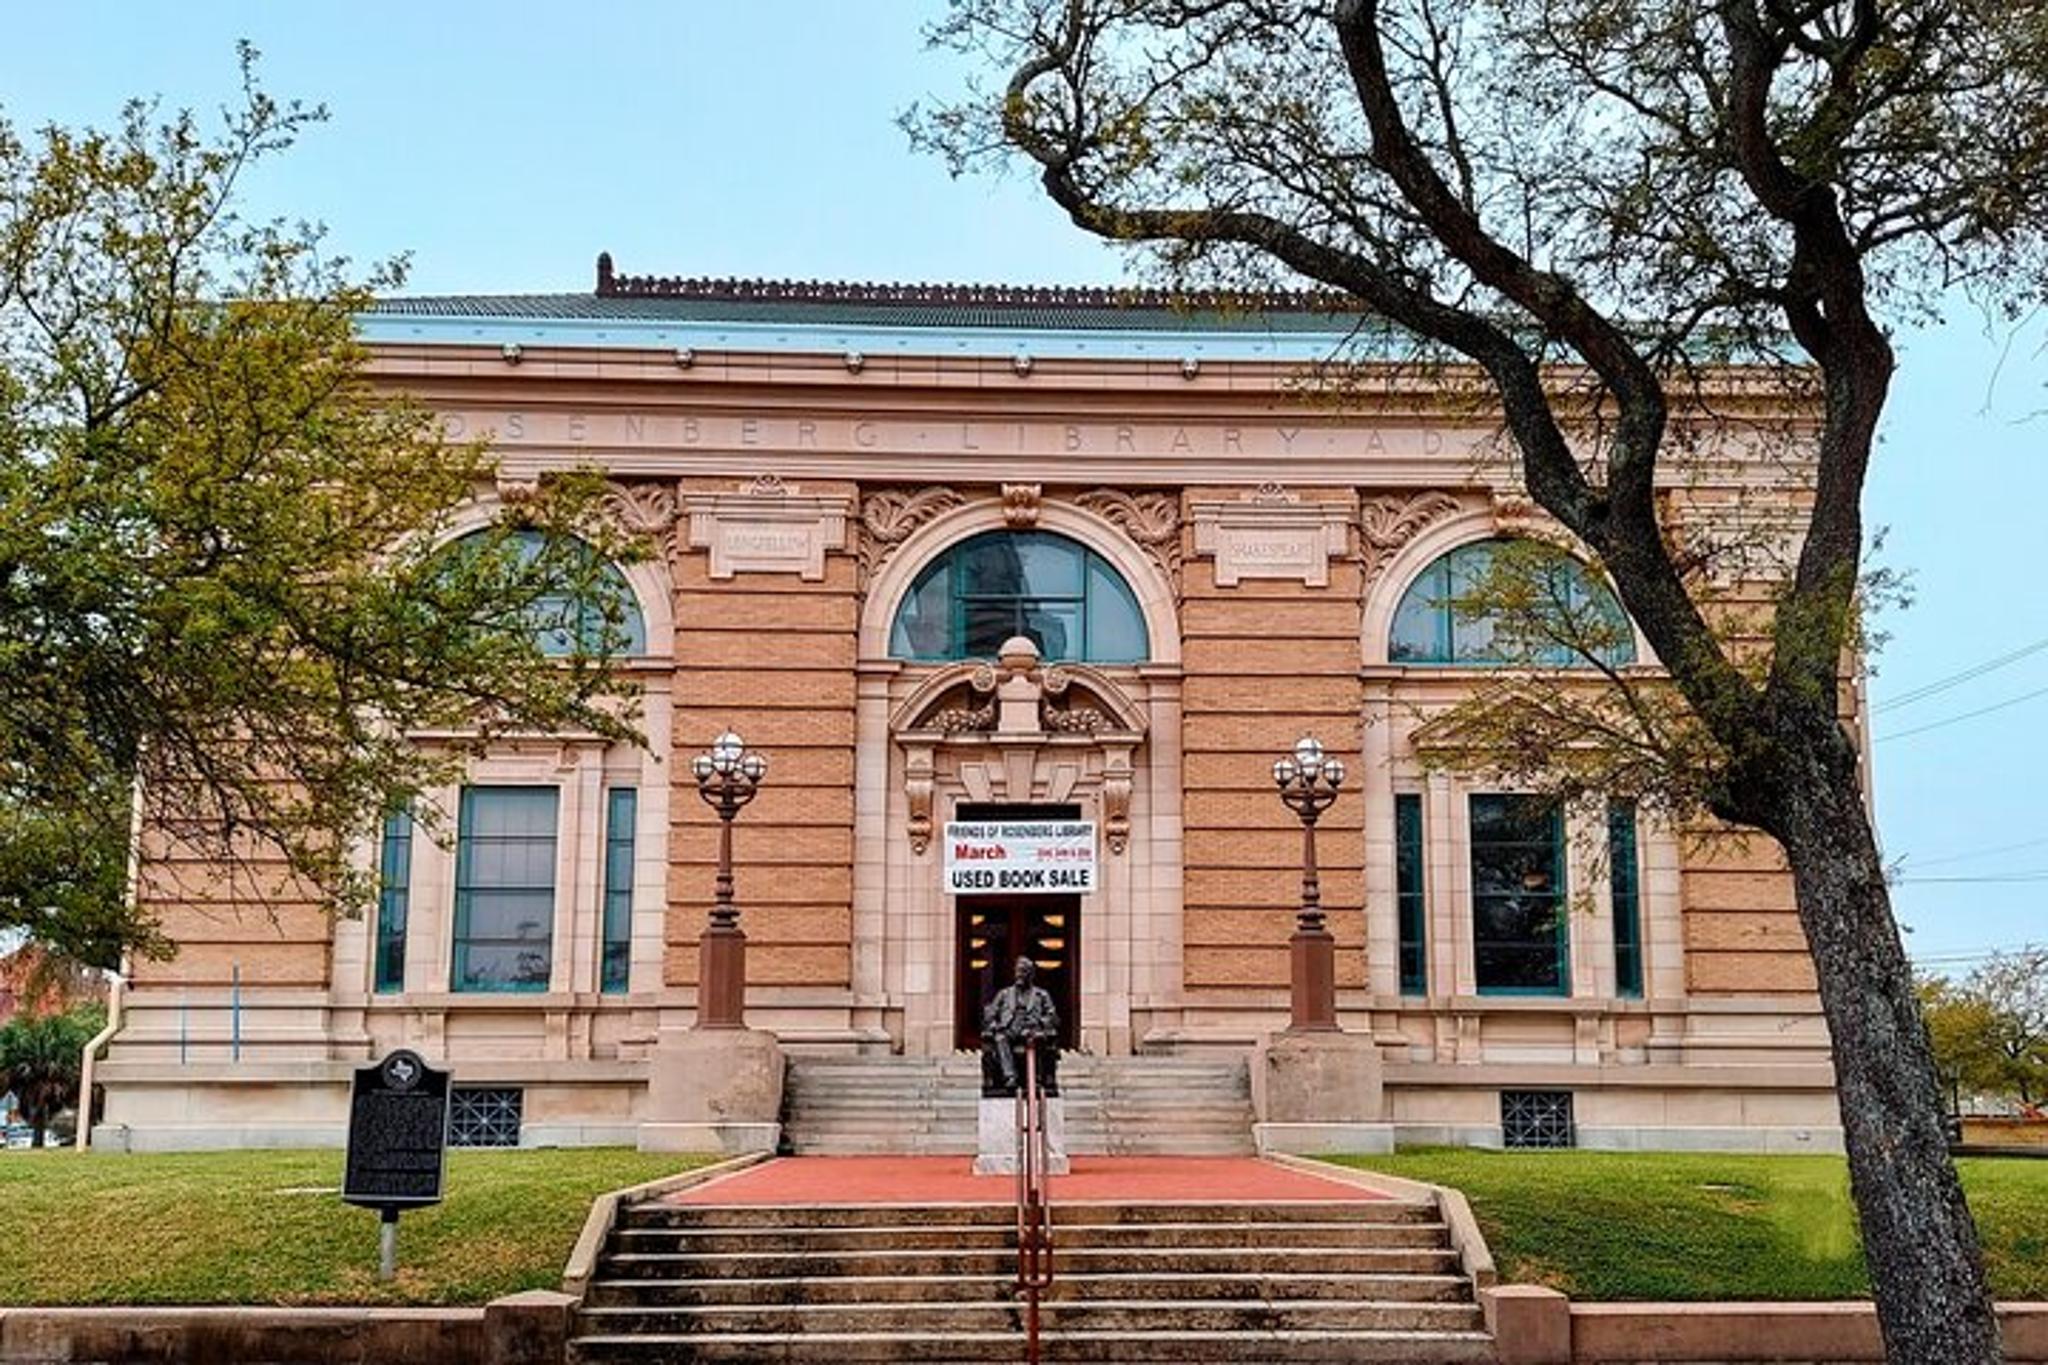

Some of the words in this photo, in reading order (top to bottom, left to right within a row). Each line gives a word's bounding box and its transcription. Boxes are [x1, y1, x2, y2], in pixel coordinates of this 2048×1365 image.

[442, 413, 879, 447] OSENBERG
[961, 422, 1302, 454] LIBRARY
[948, 824, 984, 838] FRIENDS
[988, 824, 999, 837] OF
[1001, 824, 1053, 837] ROSENBERG
[1056, 824, 1092, 837] LIBRARY
[955, 844, 1006, 860] March
[952, 870, 994, 888] USED
[999, 870, 1045, 888] BOOK
[1049, 869, 1090, 887] SALE
